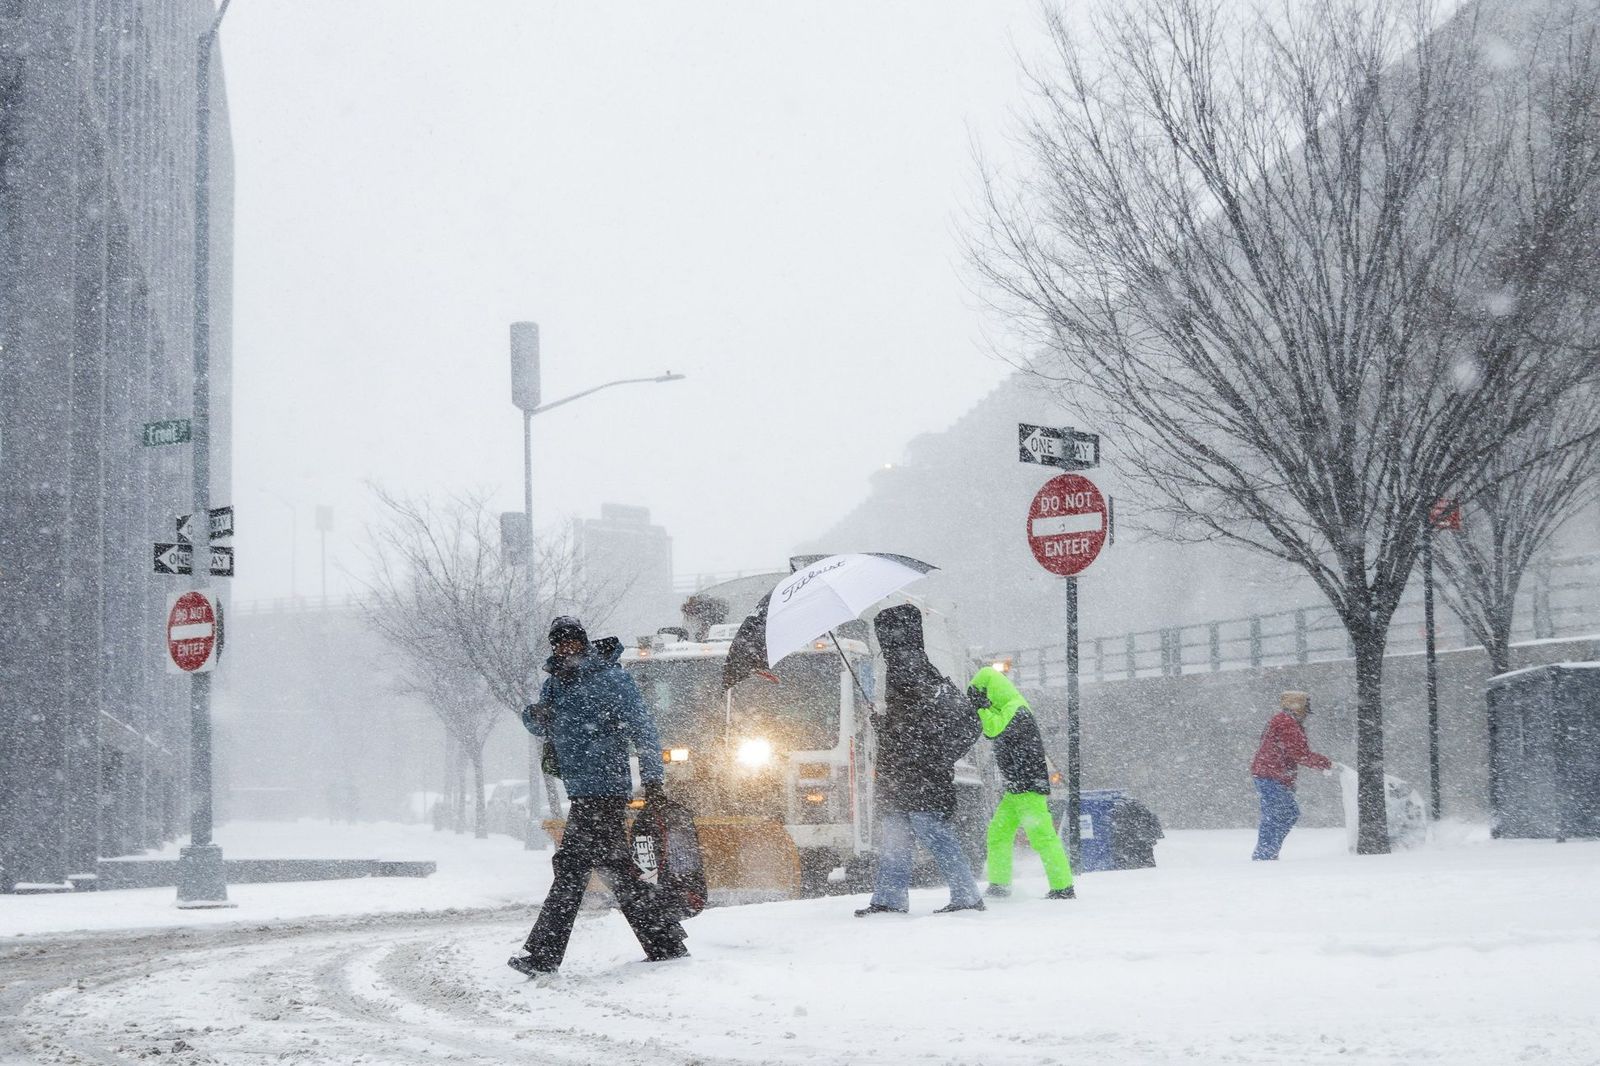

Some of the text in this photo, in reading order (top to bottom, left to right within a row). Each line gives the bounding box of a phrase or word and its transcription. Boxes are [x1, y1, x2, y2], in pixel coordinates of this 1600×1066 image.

[1030, 437, 1054, 455] ONE
[1040, 492, 1092, 512] DO NOT
[1044, 538, 1090, 557] ENTER
[169, 553, 190, 566] ONE
[177, 642, 205, 657] ENTER
[635, 835, 652, 868] REI
